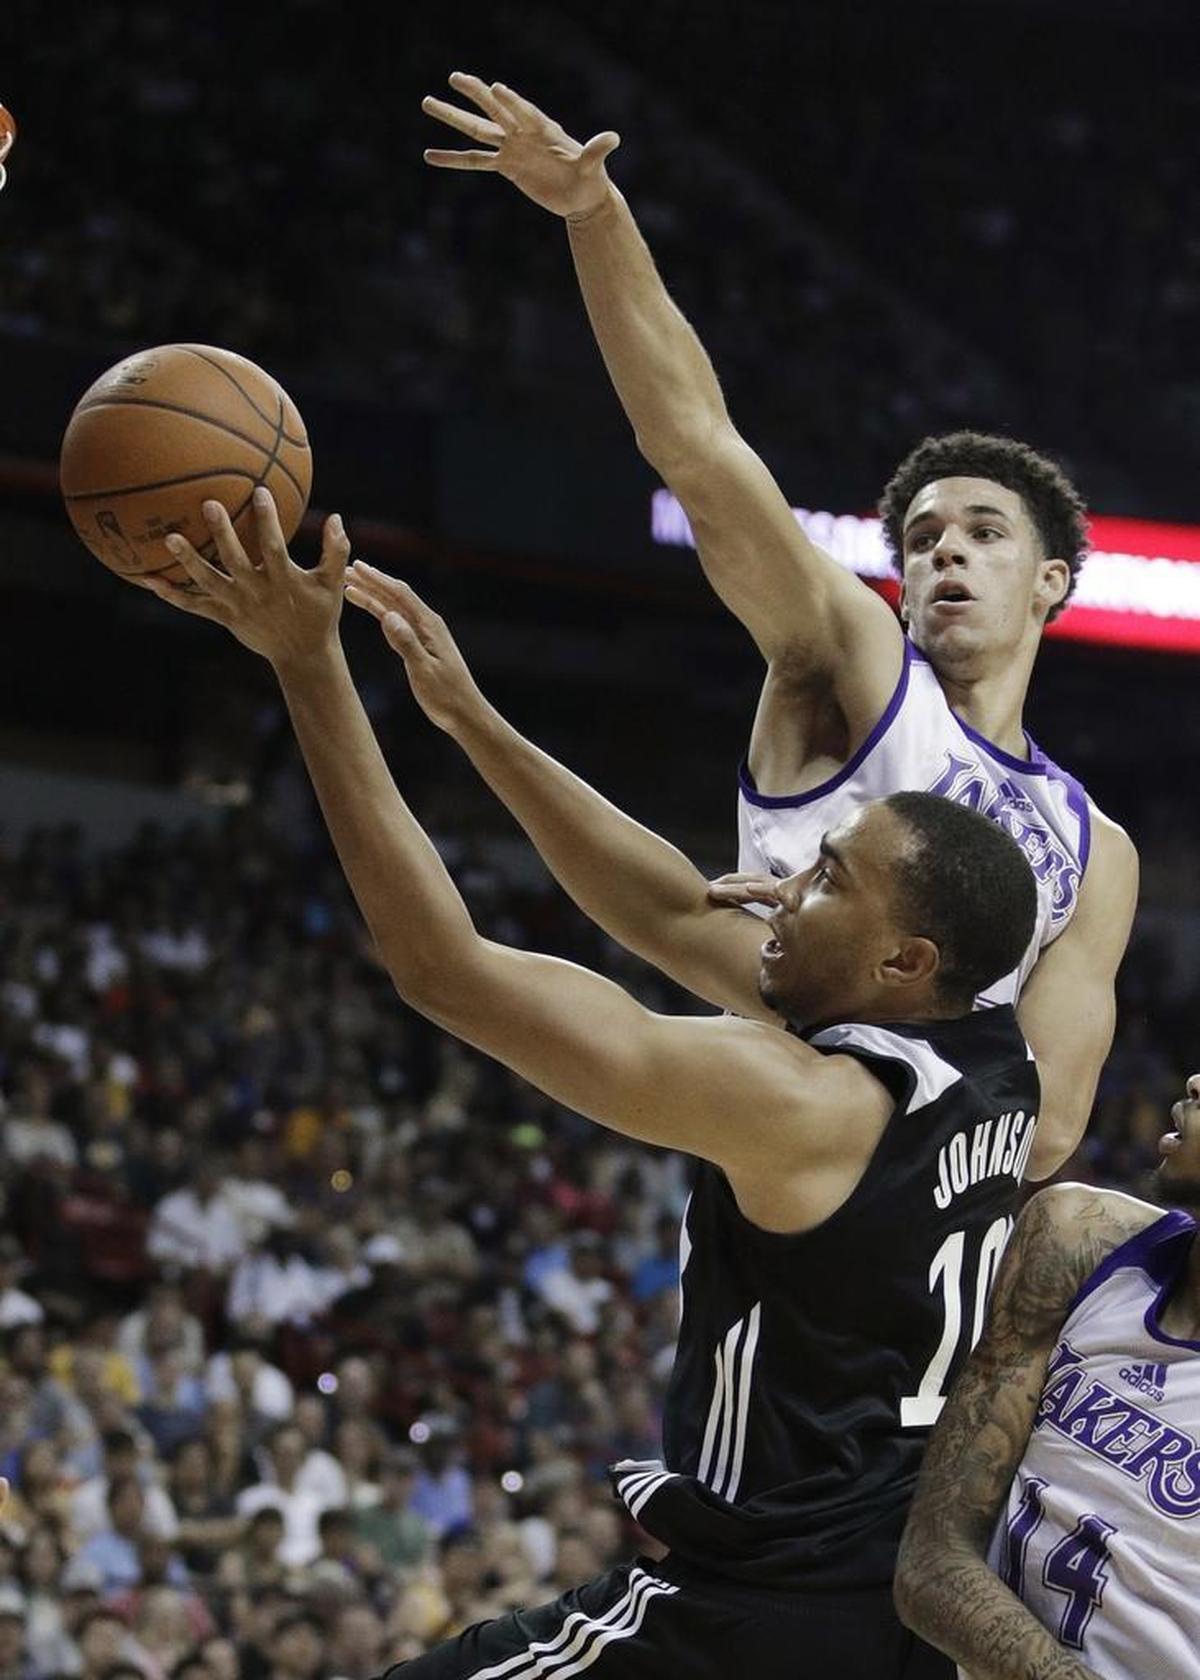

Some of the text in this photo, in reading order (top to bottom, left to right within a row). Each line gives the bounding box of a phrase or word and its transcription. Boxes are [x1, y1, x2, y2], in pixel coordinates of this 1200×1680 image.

[933, 1110, 1037, 1210] JOHNSO
[1118, 1367, 1166, 1403] adidas
[999, 1477, 1118, 1650] 14
